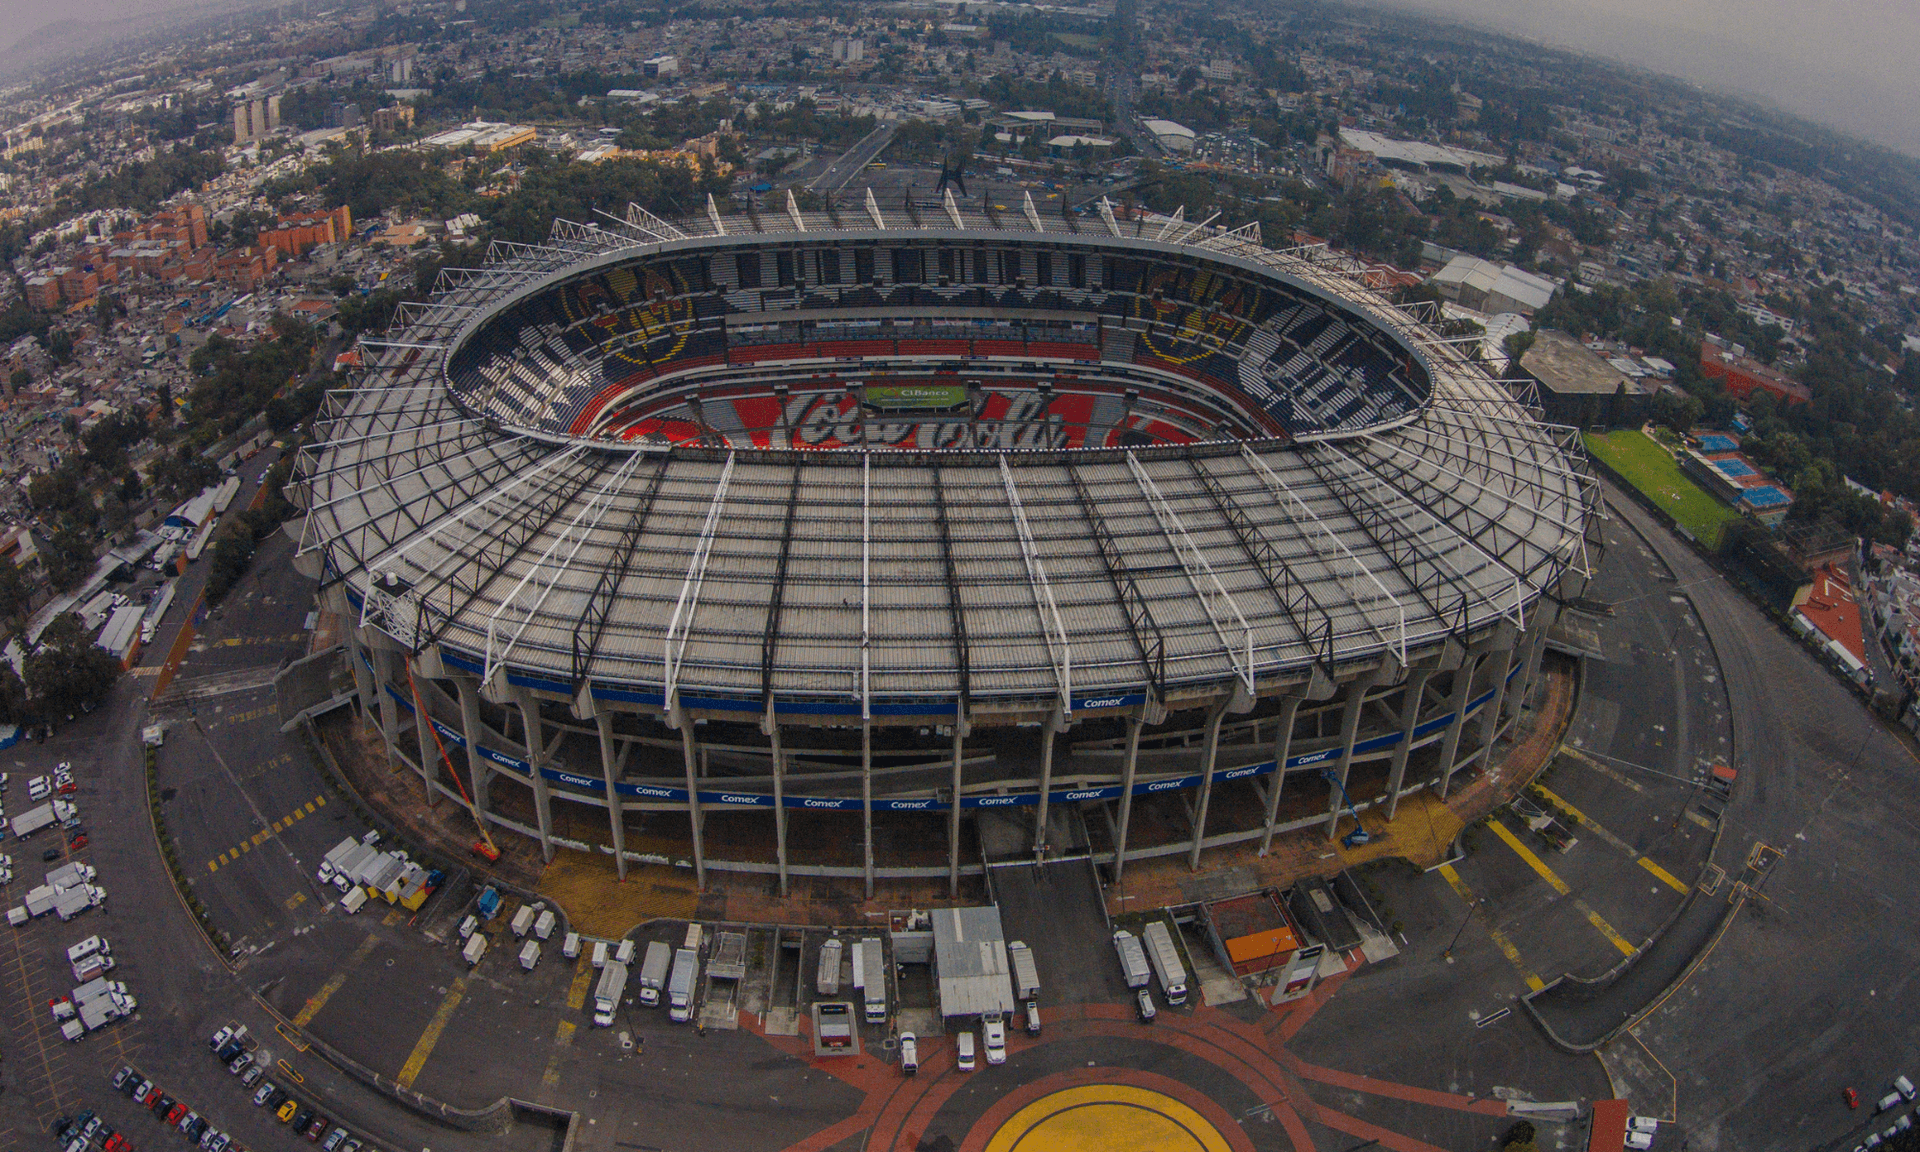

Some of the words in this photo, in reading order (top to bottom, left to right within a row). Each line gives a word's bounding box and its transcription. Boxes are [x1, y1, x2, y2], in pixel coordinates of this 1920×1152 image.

[1084, 697, 1125, 708] Comex
[492, 753, 520, 767] Comex
[1297, 751, 1329, 765] Comex
[1226, 766, 1259, 778] Comex
[560, 774, 592, 786] Comex
[1148, 779, 1184, 790] Comex
[636, 786, 672, 796] Comex
[1066, 788, 1103, 799] Comex
[721, 794, 760, 804] Comex
[804, 799, 843, 807] Comex
[891, 800, 930, 809] Comex
[979, 796, 1017, 805] Comex
